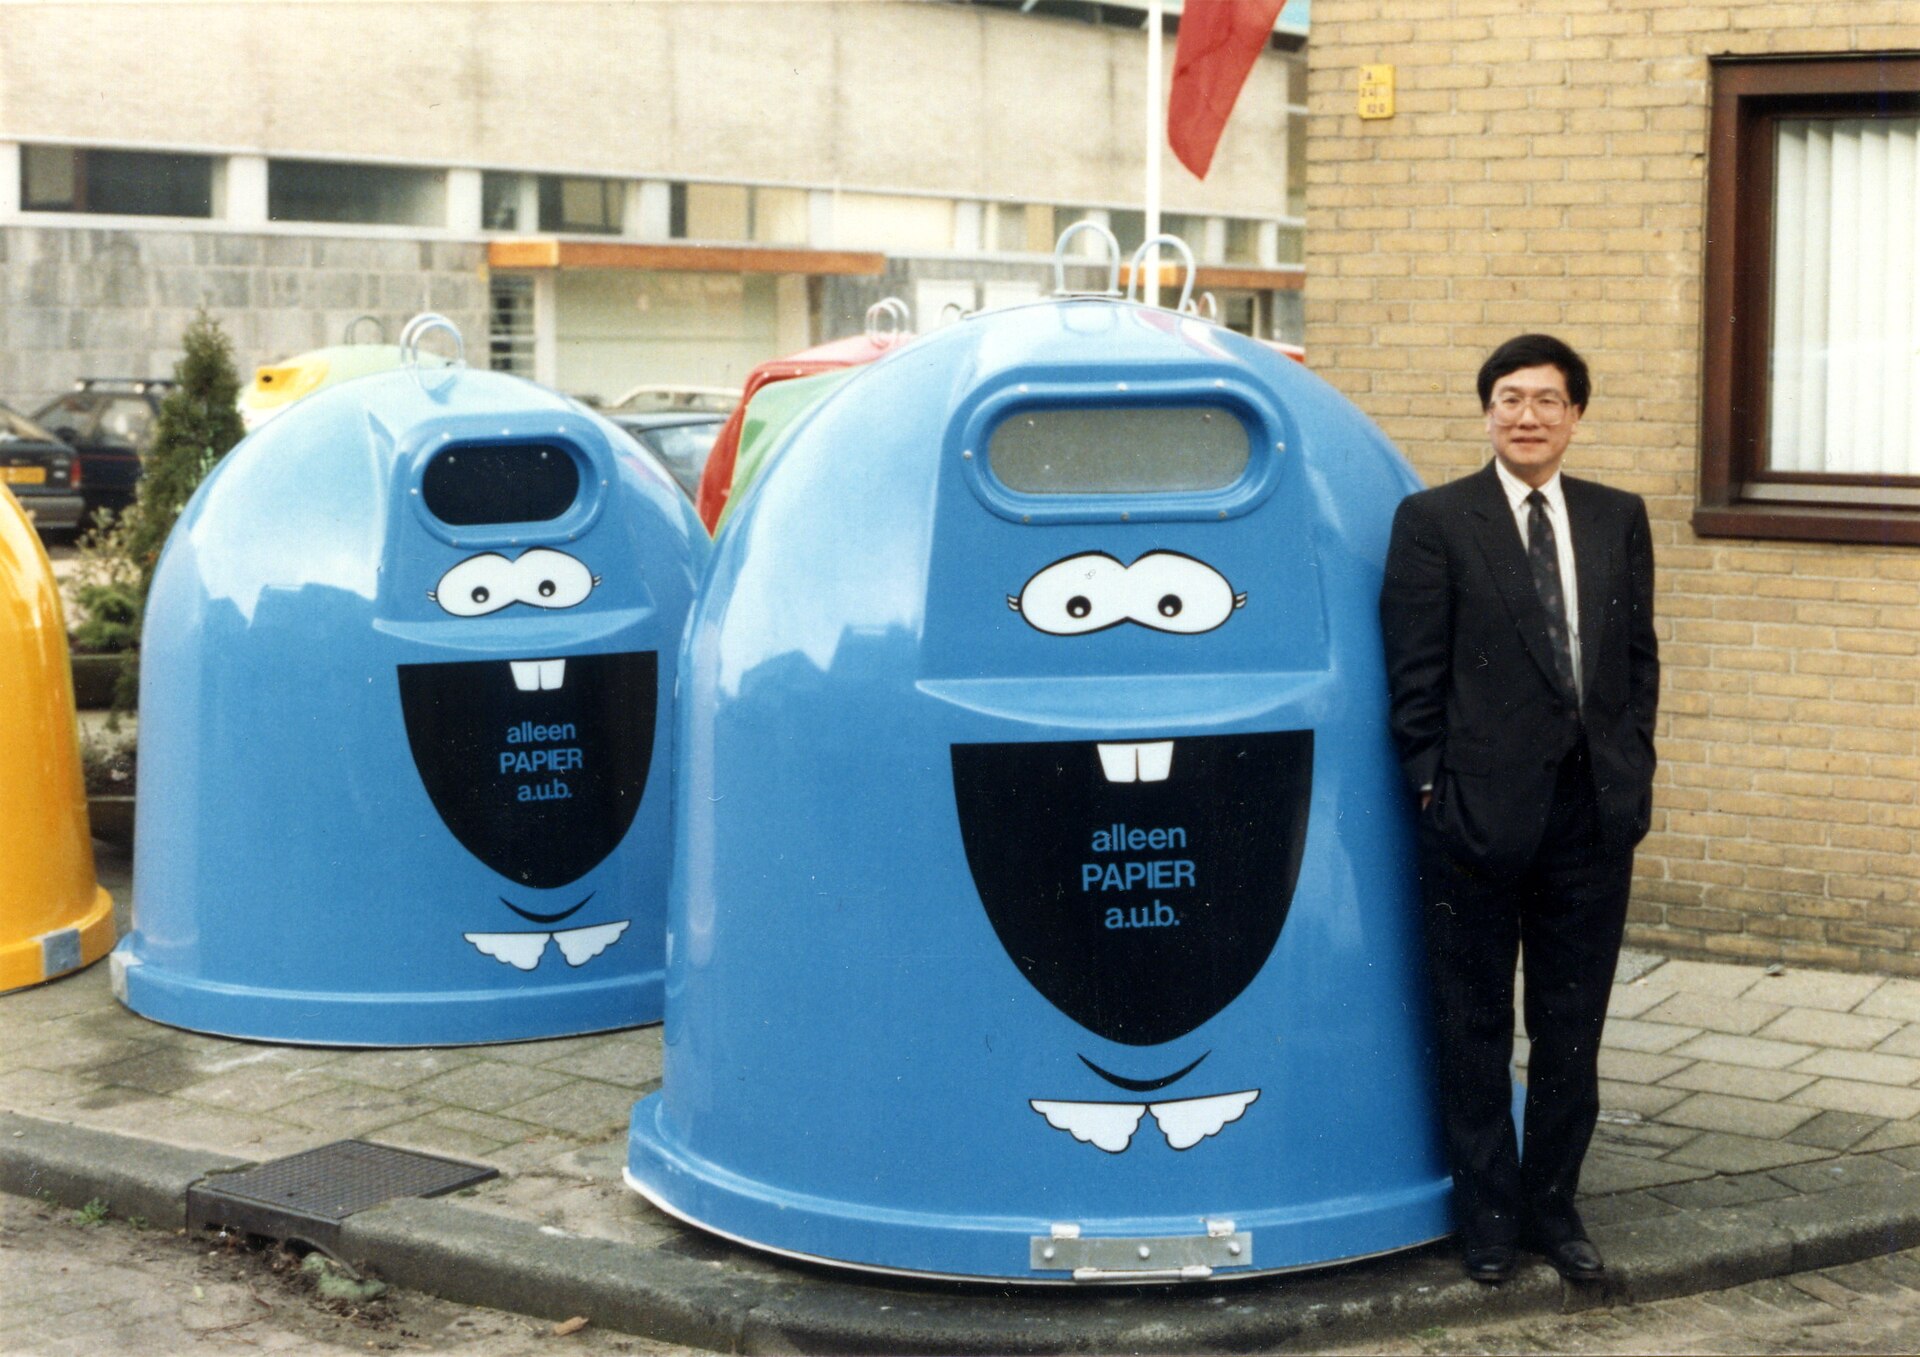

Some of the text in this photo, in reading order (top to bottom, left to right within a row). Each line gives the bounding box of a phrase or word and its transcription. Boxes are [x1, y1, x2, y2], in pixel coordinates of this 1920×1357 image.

[507, 721, 576, 744] alleen
[499, 748, 583, 774] PAPIER
[517, 778, 573, 802] a.u.b.
[1091, 823, 1187, 852] alleen
[1082, 859, 1196, 892] PAPIER
[1104, 899, 1181, 929] a.u.b.
